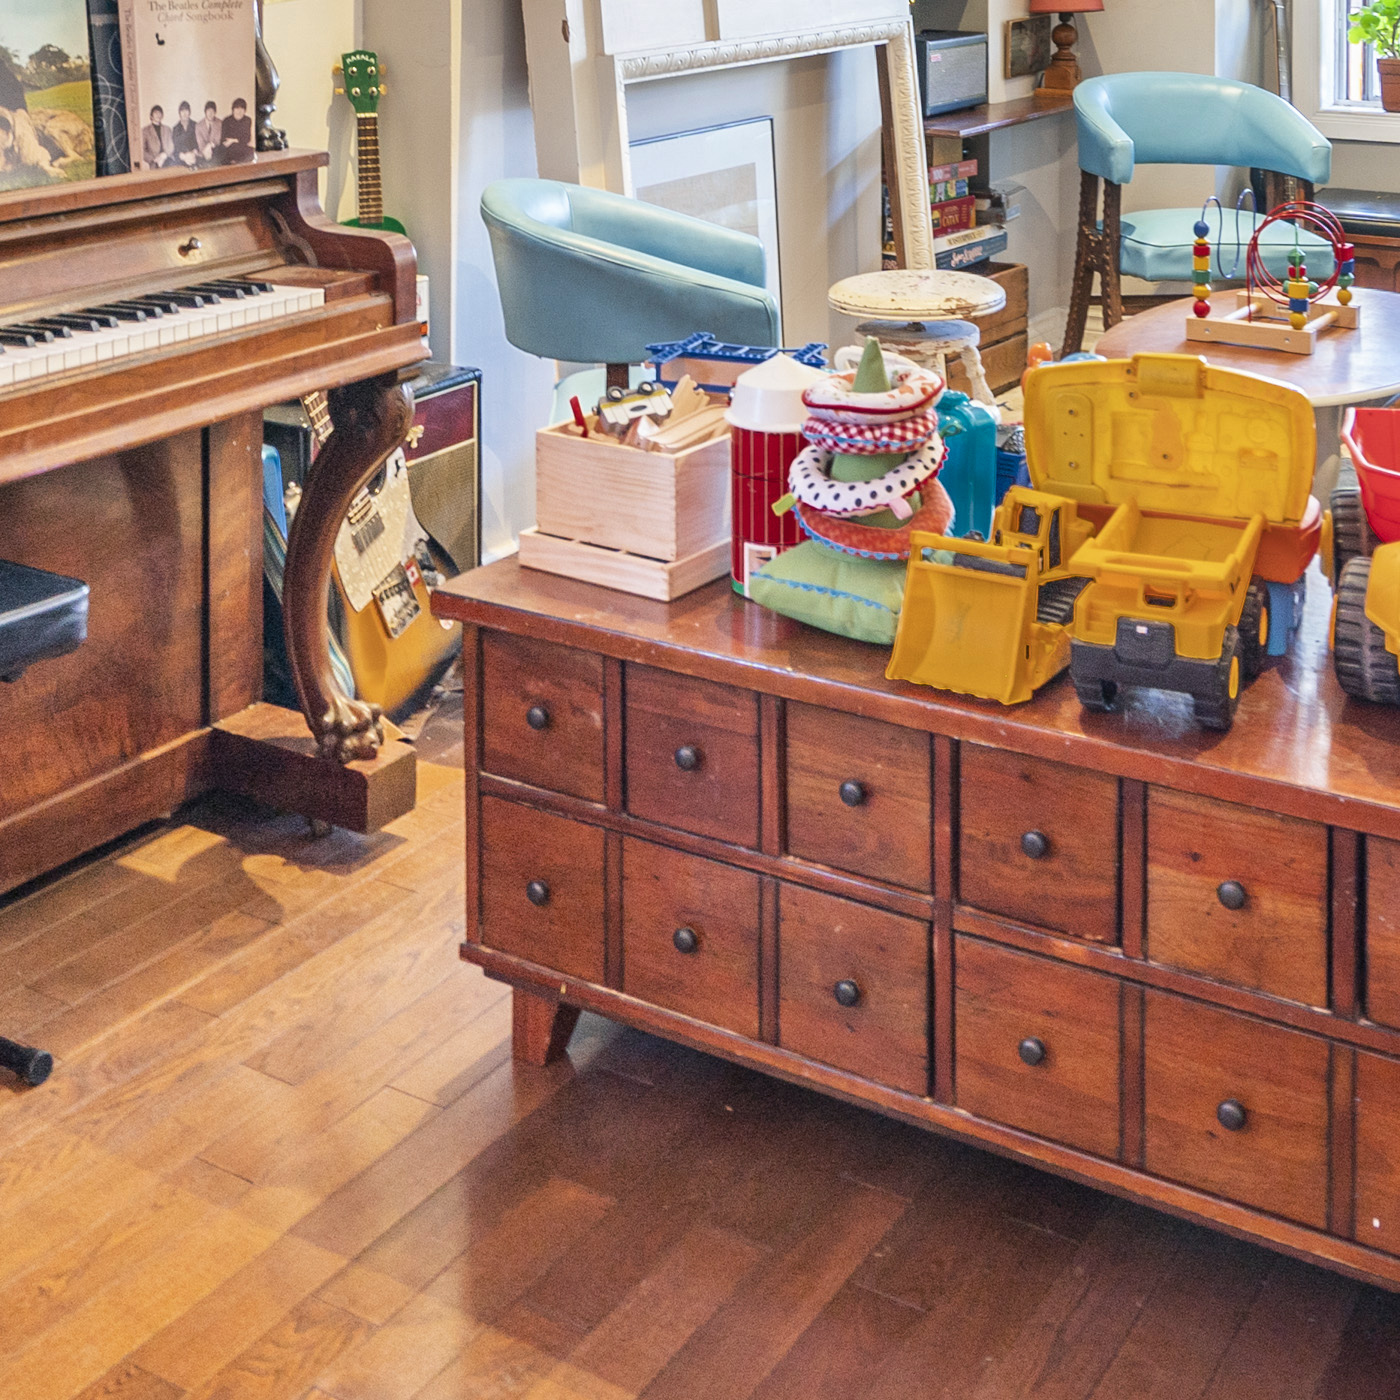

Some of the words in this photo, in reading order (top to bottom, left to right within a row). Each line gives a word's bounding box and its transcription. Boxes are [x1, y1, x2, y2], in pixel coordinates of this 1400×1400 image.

[147, 0, 167, 11] The
[168, 0, 199, 11] Beatles
[157, 11, 183, 22] Chord
[186, 10, 234, 24] Songbook
